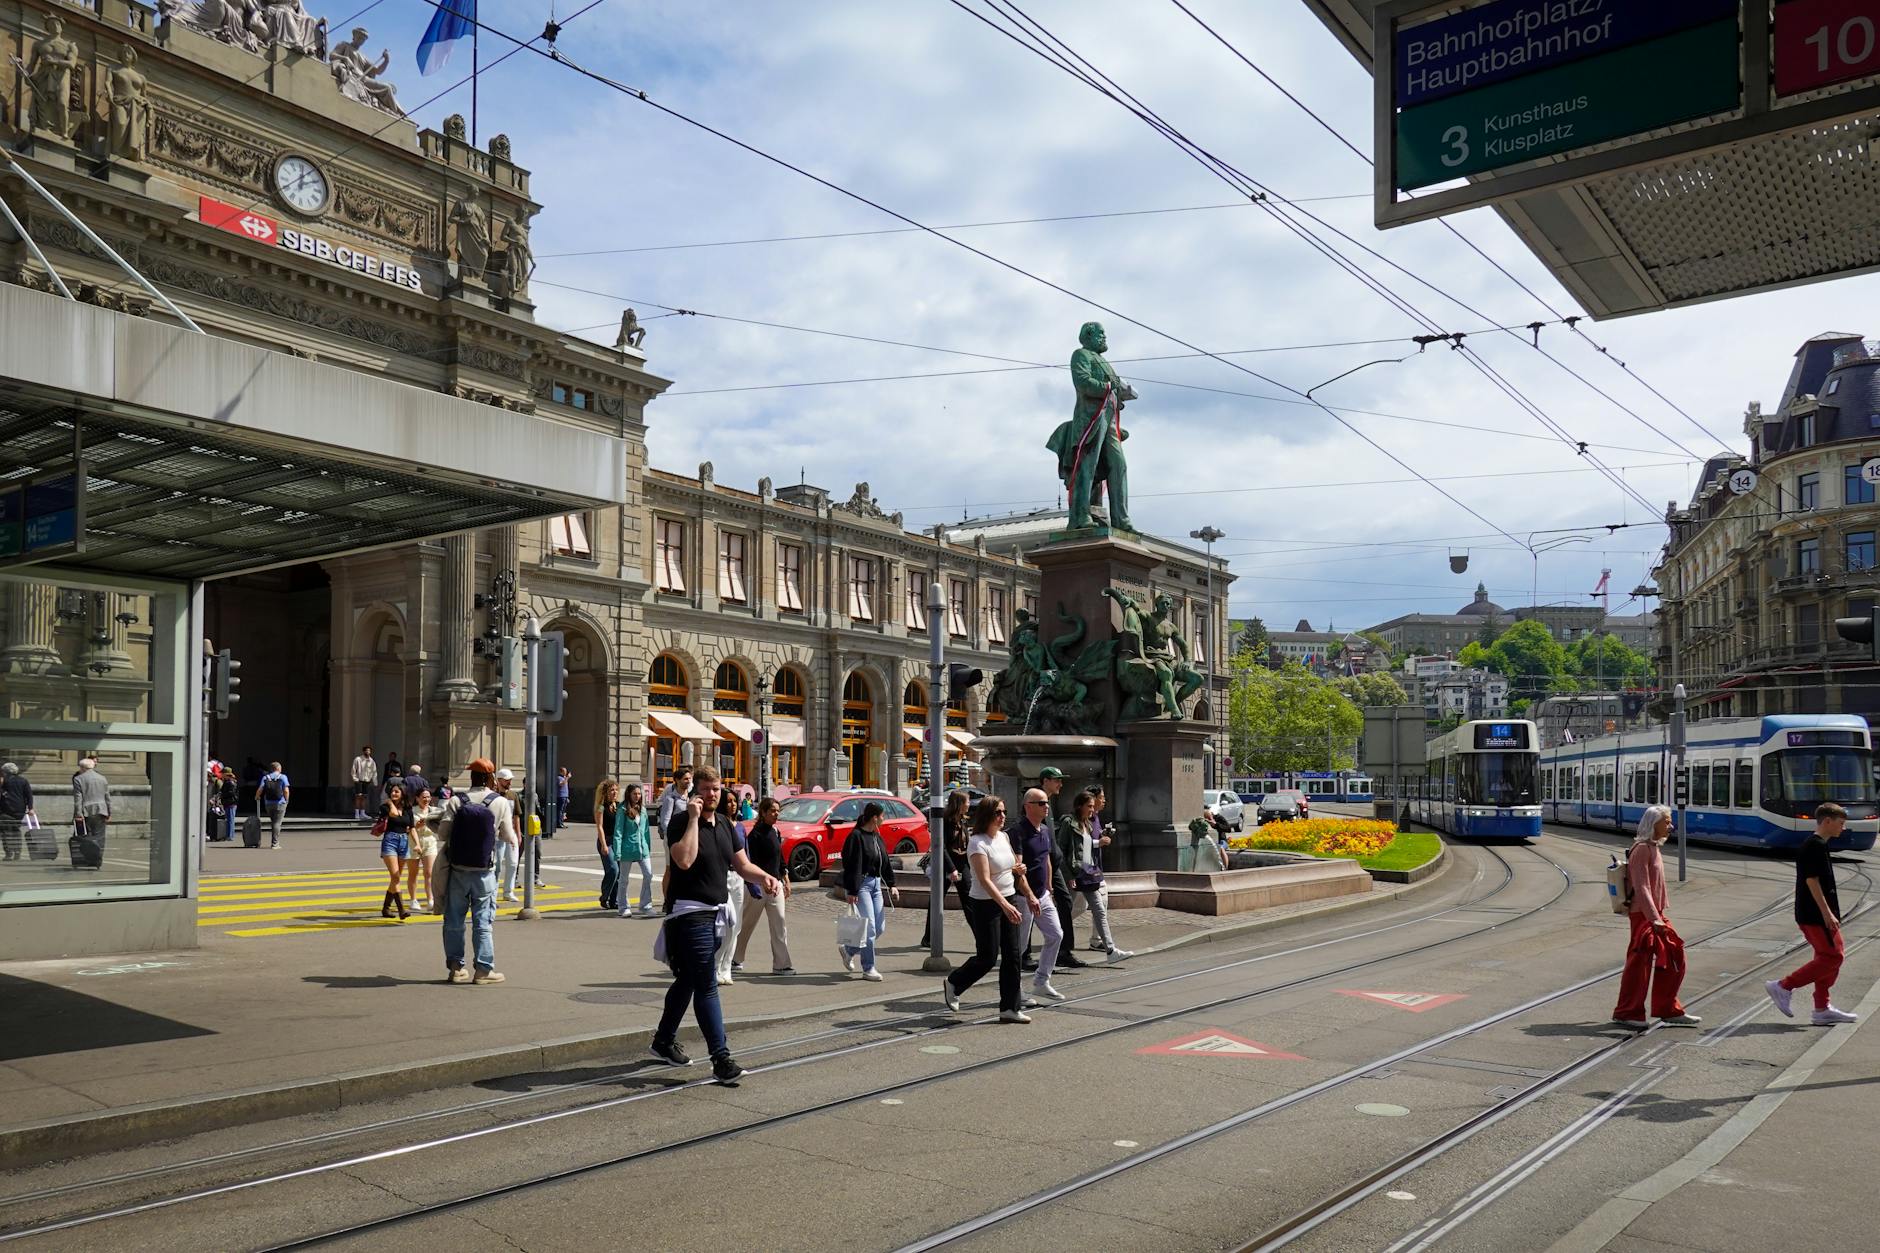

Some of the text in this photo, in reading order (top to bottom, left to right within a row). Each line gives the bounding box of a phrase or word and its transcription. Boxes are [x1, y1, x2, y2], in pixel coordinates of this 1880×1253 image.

[1407, 13, 1613, 96] Hauptbahnhof
[1804, 15, 1874, 73] 10
[1484, 95, 1589, 134] Kunsthaus
[1441, 125, 1471, 168] 3
[1484, 122, 1575, 158] Klusplatz
[282, 229, 332, 260] SBB
[1735, 476, 1752, 488] 14
[1495, 726, 1508, 736] 14
[1790, 734, 1803, 744] 17
